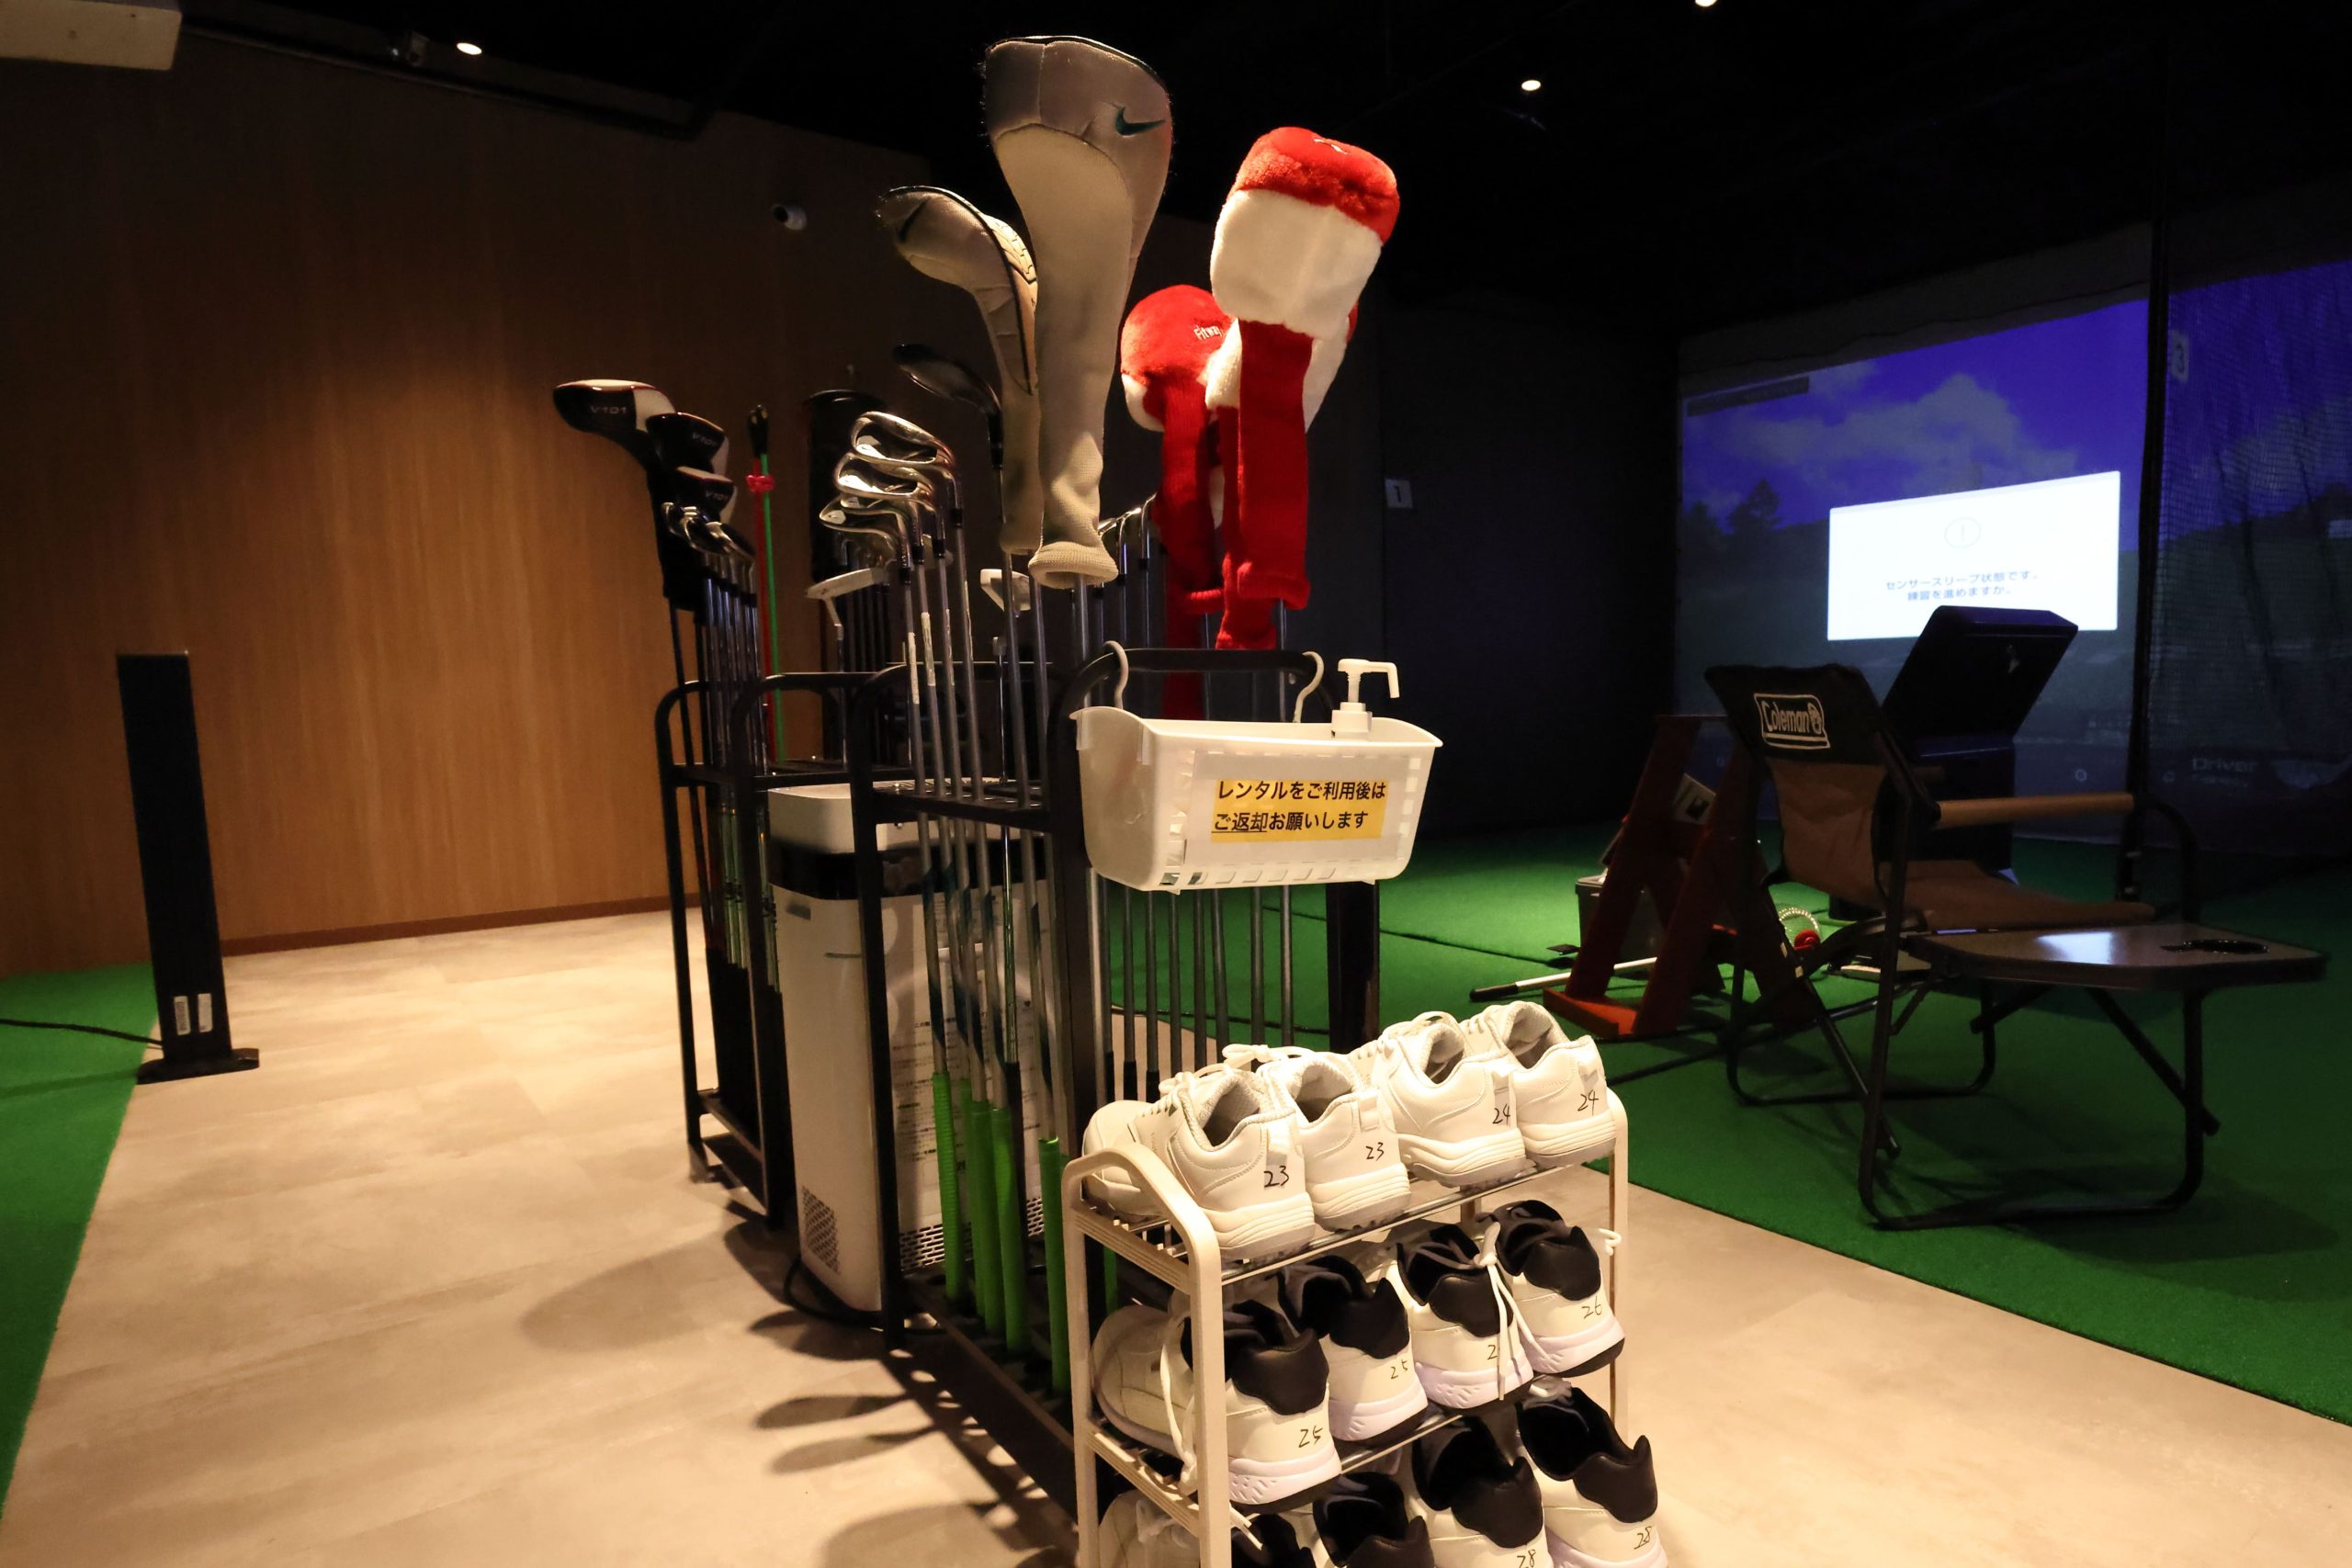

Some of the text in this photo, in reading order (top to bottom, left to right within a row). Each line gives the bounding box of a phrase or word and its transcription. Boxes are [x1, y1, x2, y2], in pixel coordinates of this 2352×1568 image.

[1761, 700, 1810, 733] Coleman
[1218, 781, 1386, 800] レンタルをご利用後は
[1214, 811, 1369, 832] ご返却お願いします
[1492, 1103, 1511, 1127] 24
[1577, 1089, 1600, 1117] 24
[1365, 1142, 1385, 1161] 23
[1263, 1165, 1290, 1189] 23
[1390, 1359, 1408, 1380] 25
[1298, 1425, 1324, 1449] 25
